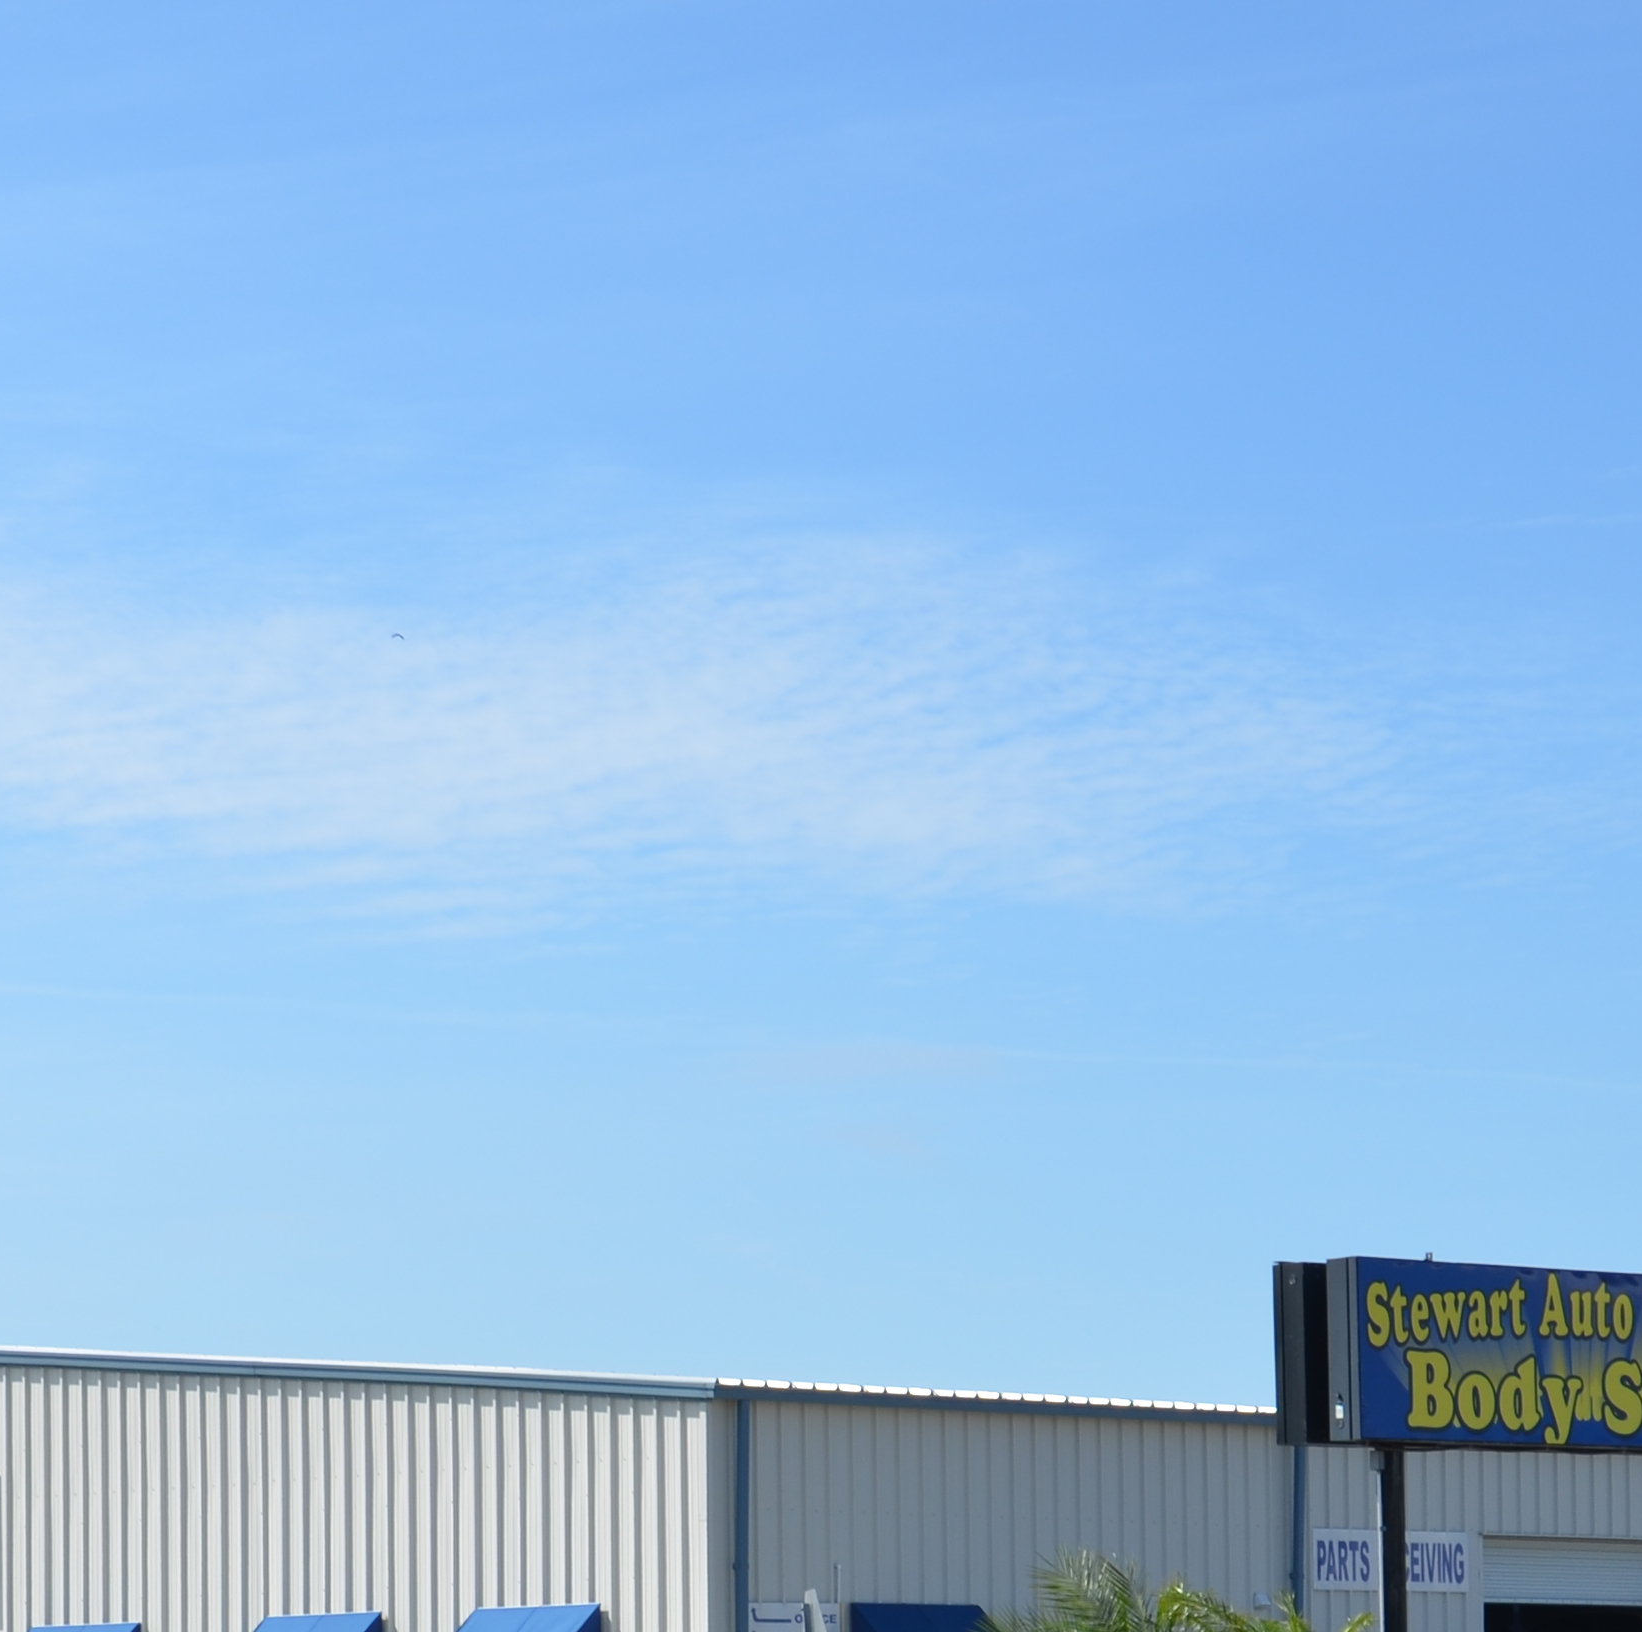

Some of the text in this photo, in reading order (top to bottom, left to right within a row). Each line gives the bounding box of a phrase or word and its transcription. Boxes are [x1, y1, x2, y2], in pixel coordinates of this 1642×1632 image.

[1366, 1278, 1526, 1347] Stewart
[1539, 1272, 1634, 1340] Auto
[1405, 1348, 1583, 1445] Body
[1316, 1540, 1465, 1584] PARTS EIVING
